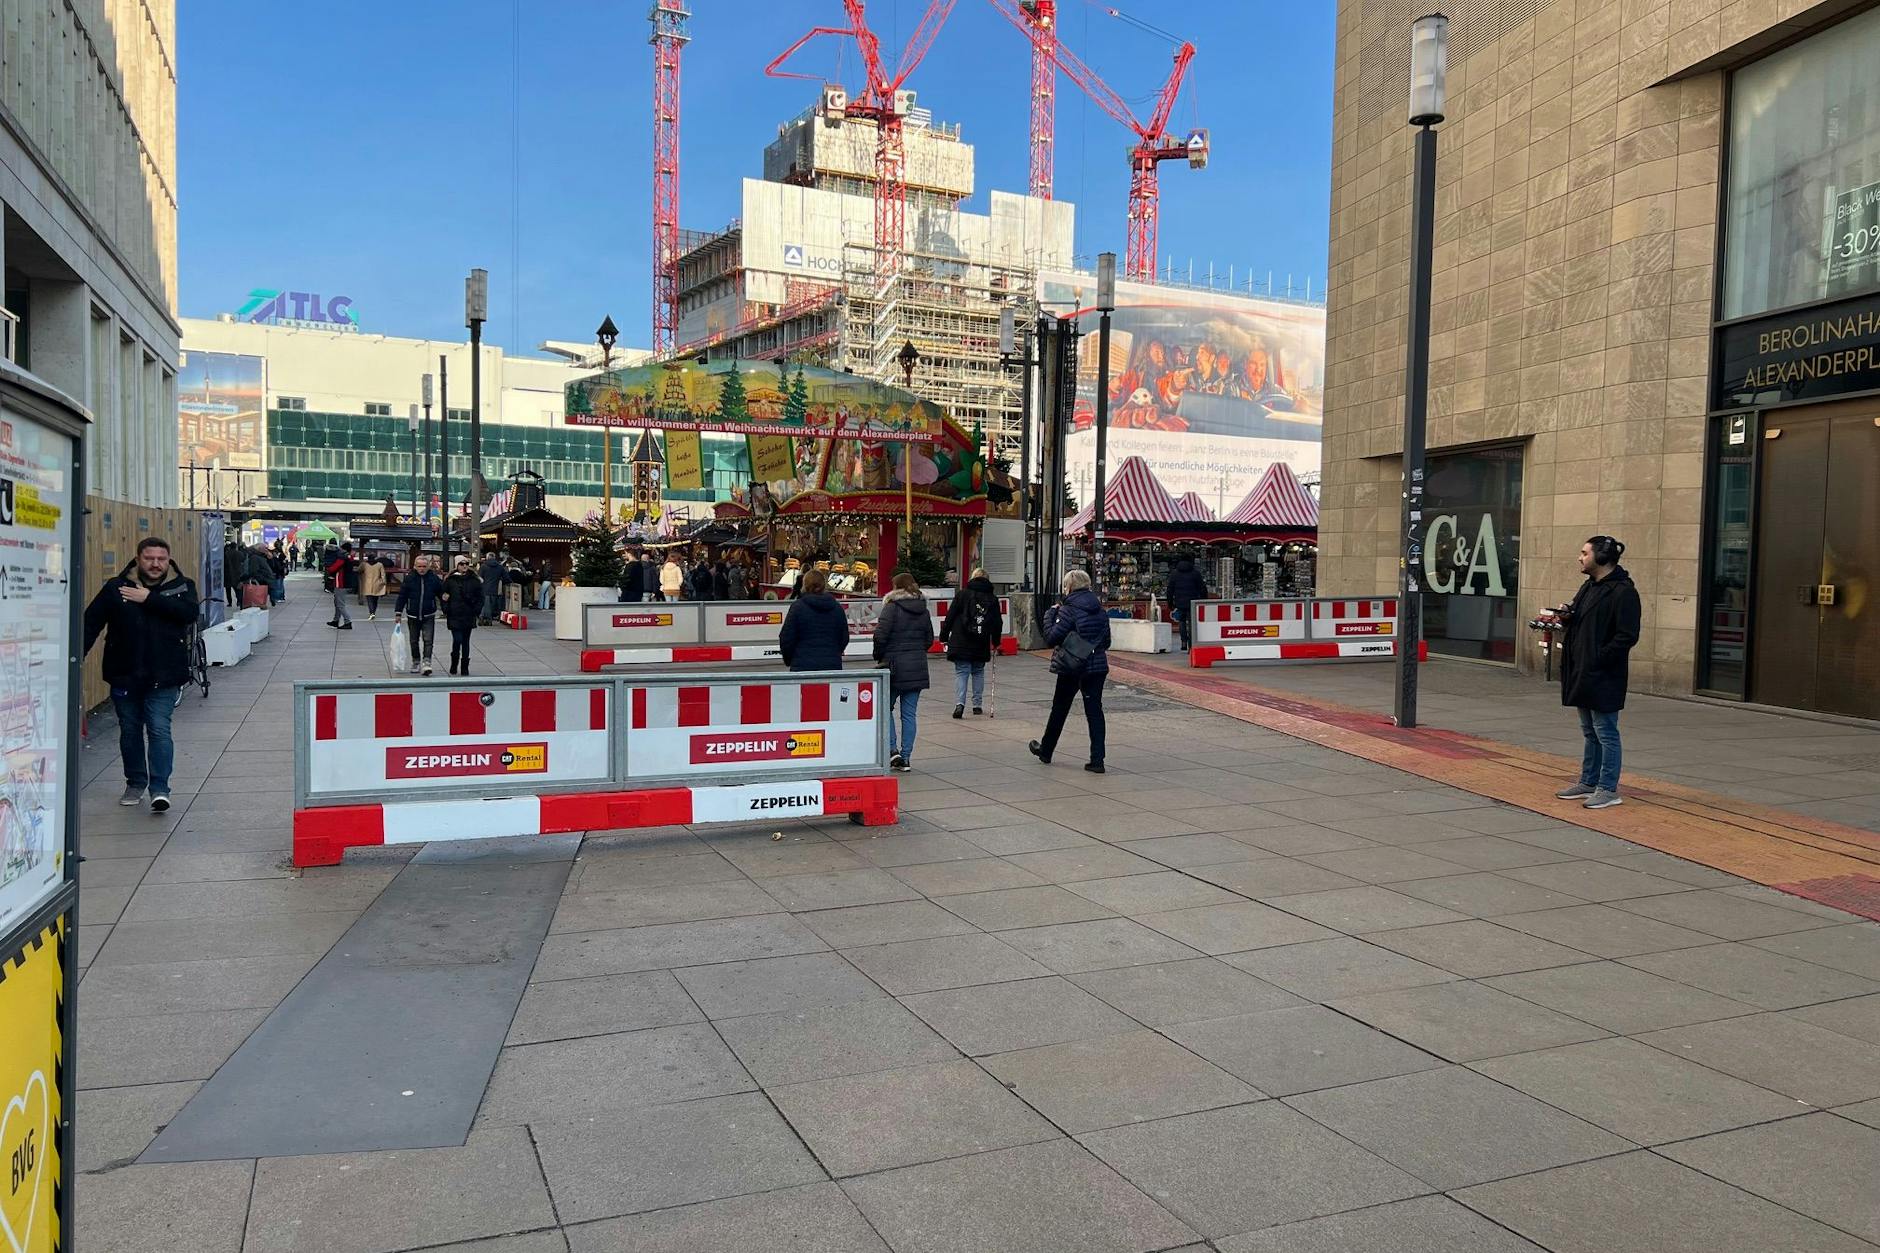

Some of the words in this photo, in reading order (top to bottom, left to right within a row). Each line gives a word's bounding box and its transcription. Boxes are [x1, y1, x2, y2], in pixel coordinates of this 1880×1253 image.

[1837, 197, 1863, 220] Black
[1834, 225, 1880, 258] -30%
[1743, 347, 1880, 389] ALEXANDERPL
[576, 414, 624, 426] Herzlich
[627, 417, 696, 430] willkommen
[724, 422, 816, 436] Weihnachtsmarkt
[818, 427, 836, 437] auf
[837, 430, 859, 438] dem
[860, 429, 933, 441] Alexanderplatz
[1159, 462, 1205, 472] unendliche
[1424, 513, 1507, 596] C&A
[732, 615, 763, 623] ZEPPELIN
[705, 740, 778, 755] ZEPPELIN
[798, 740, 820, 748] Rental
[404, 754, 492, 769] ZEPPELIN
[515, 754, 542, 762] Rental
[750, 795, 819, 810] ZEPPELIN
[11, 1127, 35, 1196] BVG
